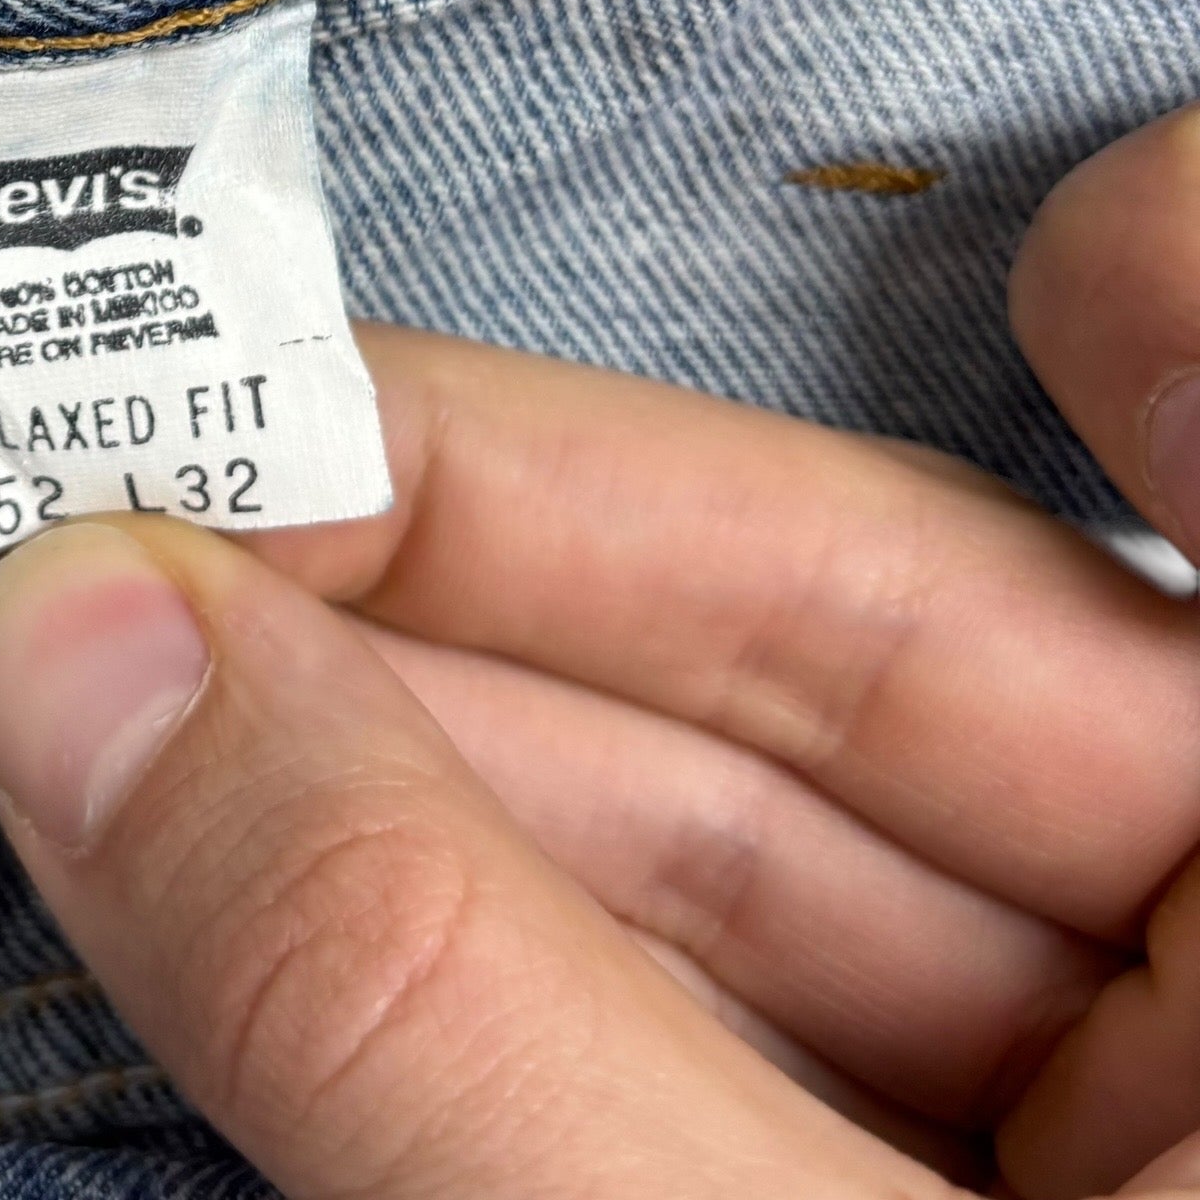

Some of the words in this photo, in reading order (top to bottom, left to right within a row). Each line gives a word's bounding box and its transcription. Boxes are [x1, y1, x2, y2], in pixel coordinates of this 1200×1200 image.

[57, 304, 86, 328] IN
[186, 374, 267, 439] FIT
[123, 457, 263, 513] L32
